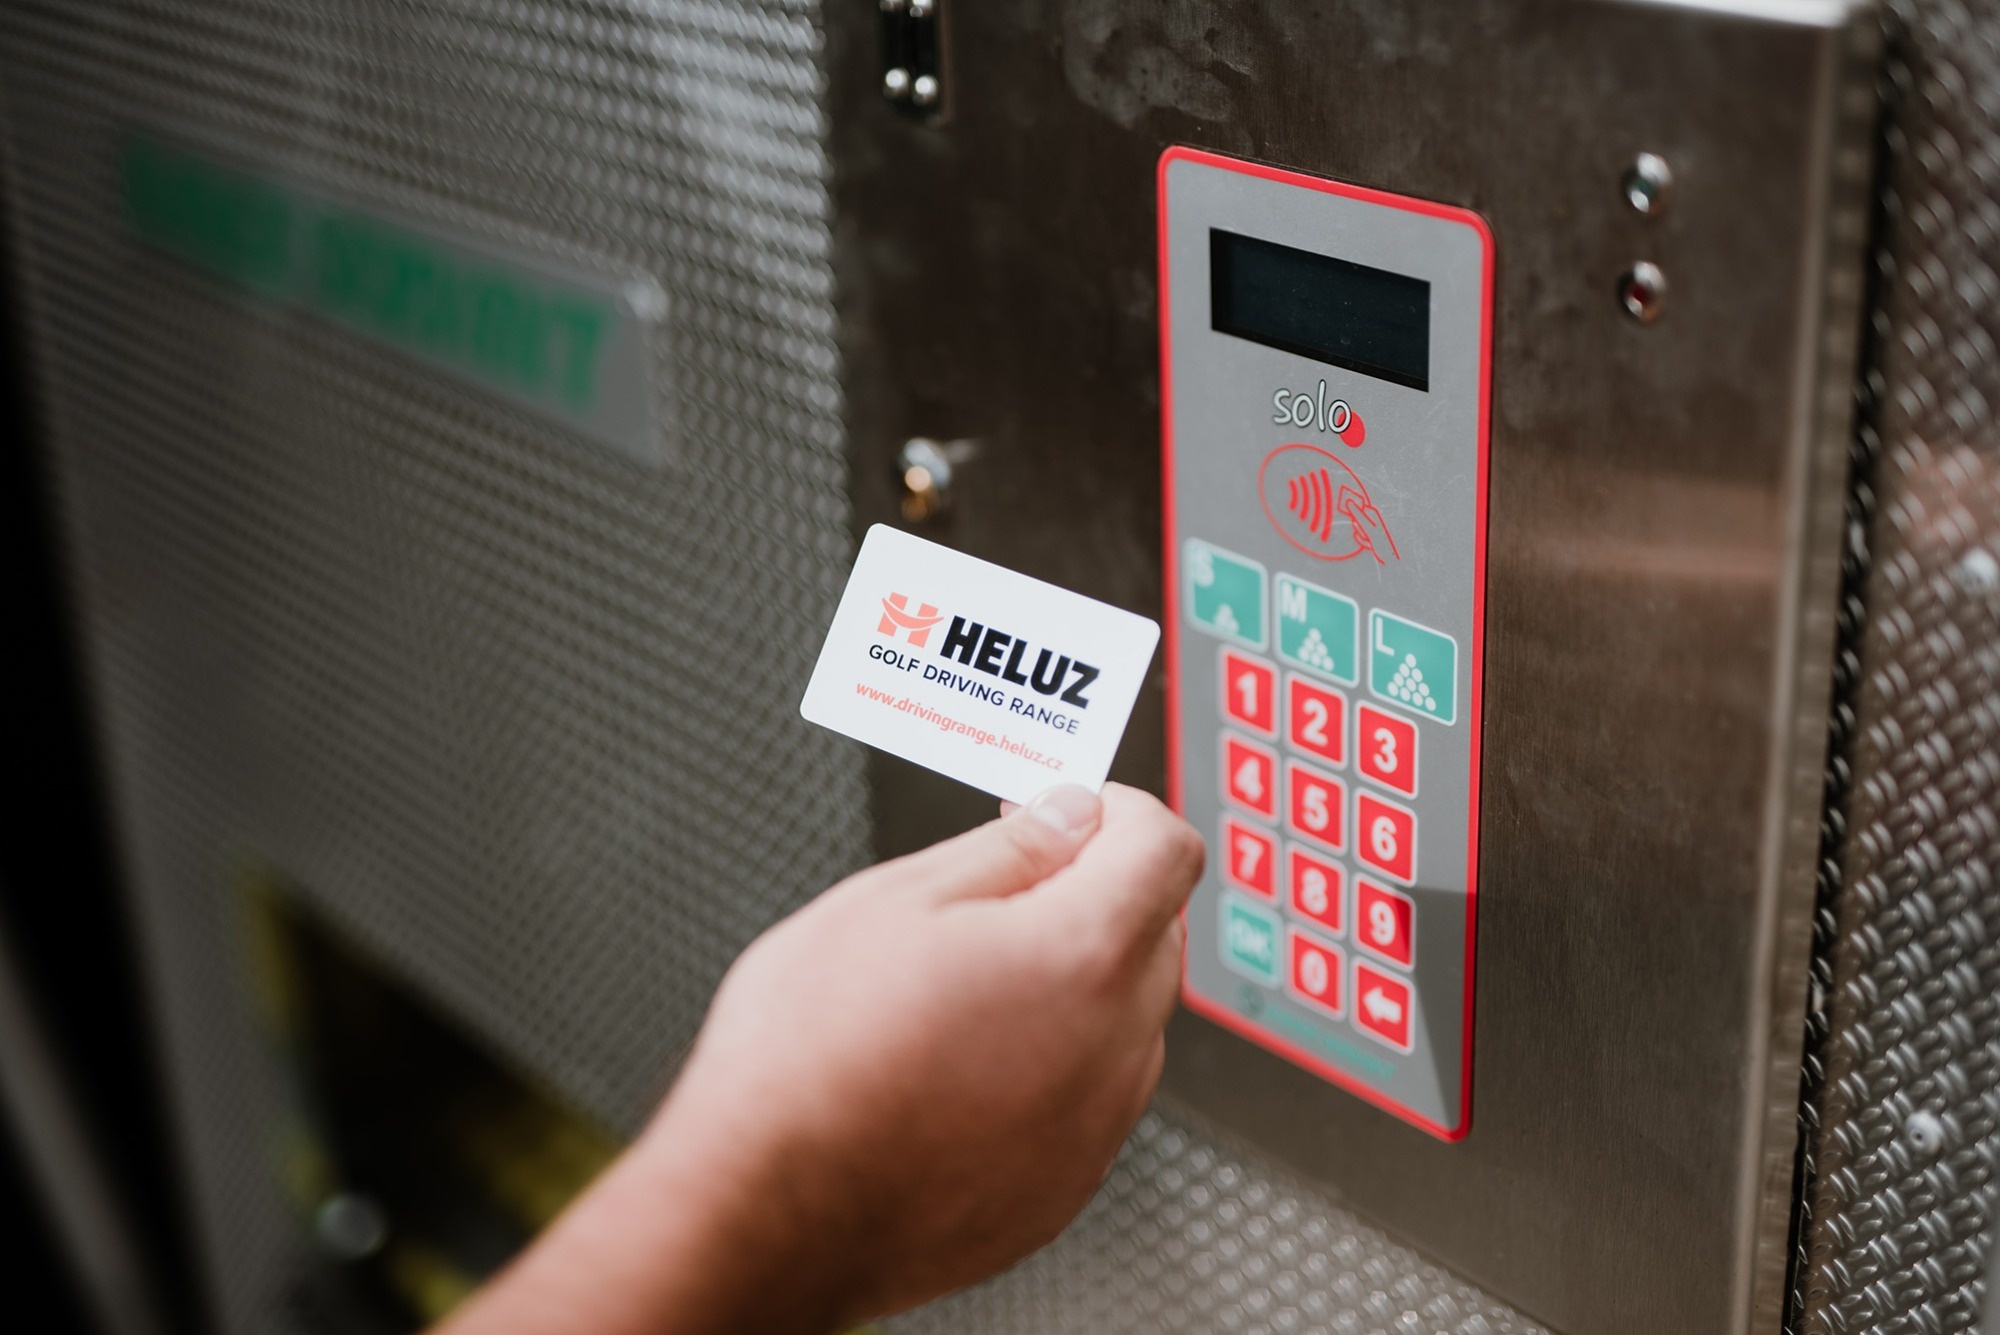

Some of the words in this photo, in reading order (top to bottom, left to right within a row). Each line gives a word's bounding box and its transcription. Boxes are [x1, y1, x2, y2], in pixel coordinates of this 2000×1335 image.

[1273, 379, 1352, 433] solo
[1190, 547, 1214, 587] S
[1281, 581, 1307, 624] M
[1375, 616, 1395, 656] L
[940, 615, 1100, 709] HELUZ
[869, 644, 920, 672] GOLF
[923, 664, 1004, 705] DRIVING
[1010, 698, 1080, 734] RANGE
[1236, 671, 1257, 717] 1
[856, 682, 1064, 771] www.drivingrange.heluz.cz
[1303, 698, 1328, 747] 2
[1374, 727, 1397, 773] 3
[1234, 758, 1263, 801] 4
[1303, 784, 1329, 831] 5
[1236, 834, 1264, 880] 7
[1371, 816, 1397, 862] 6
[1301, 867, 1328, 915] 8
[1369, 901, 1396, 946] 9
[1301, 950, 1328, 995] 0
